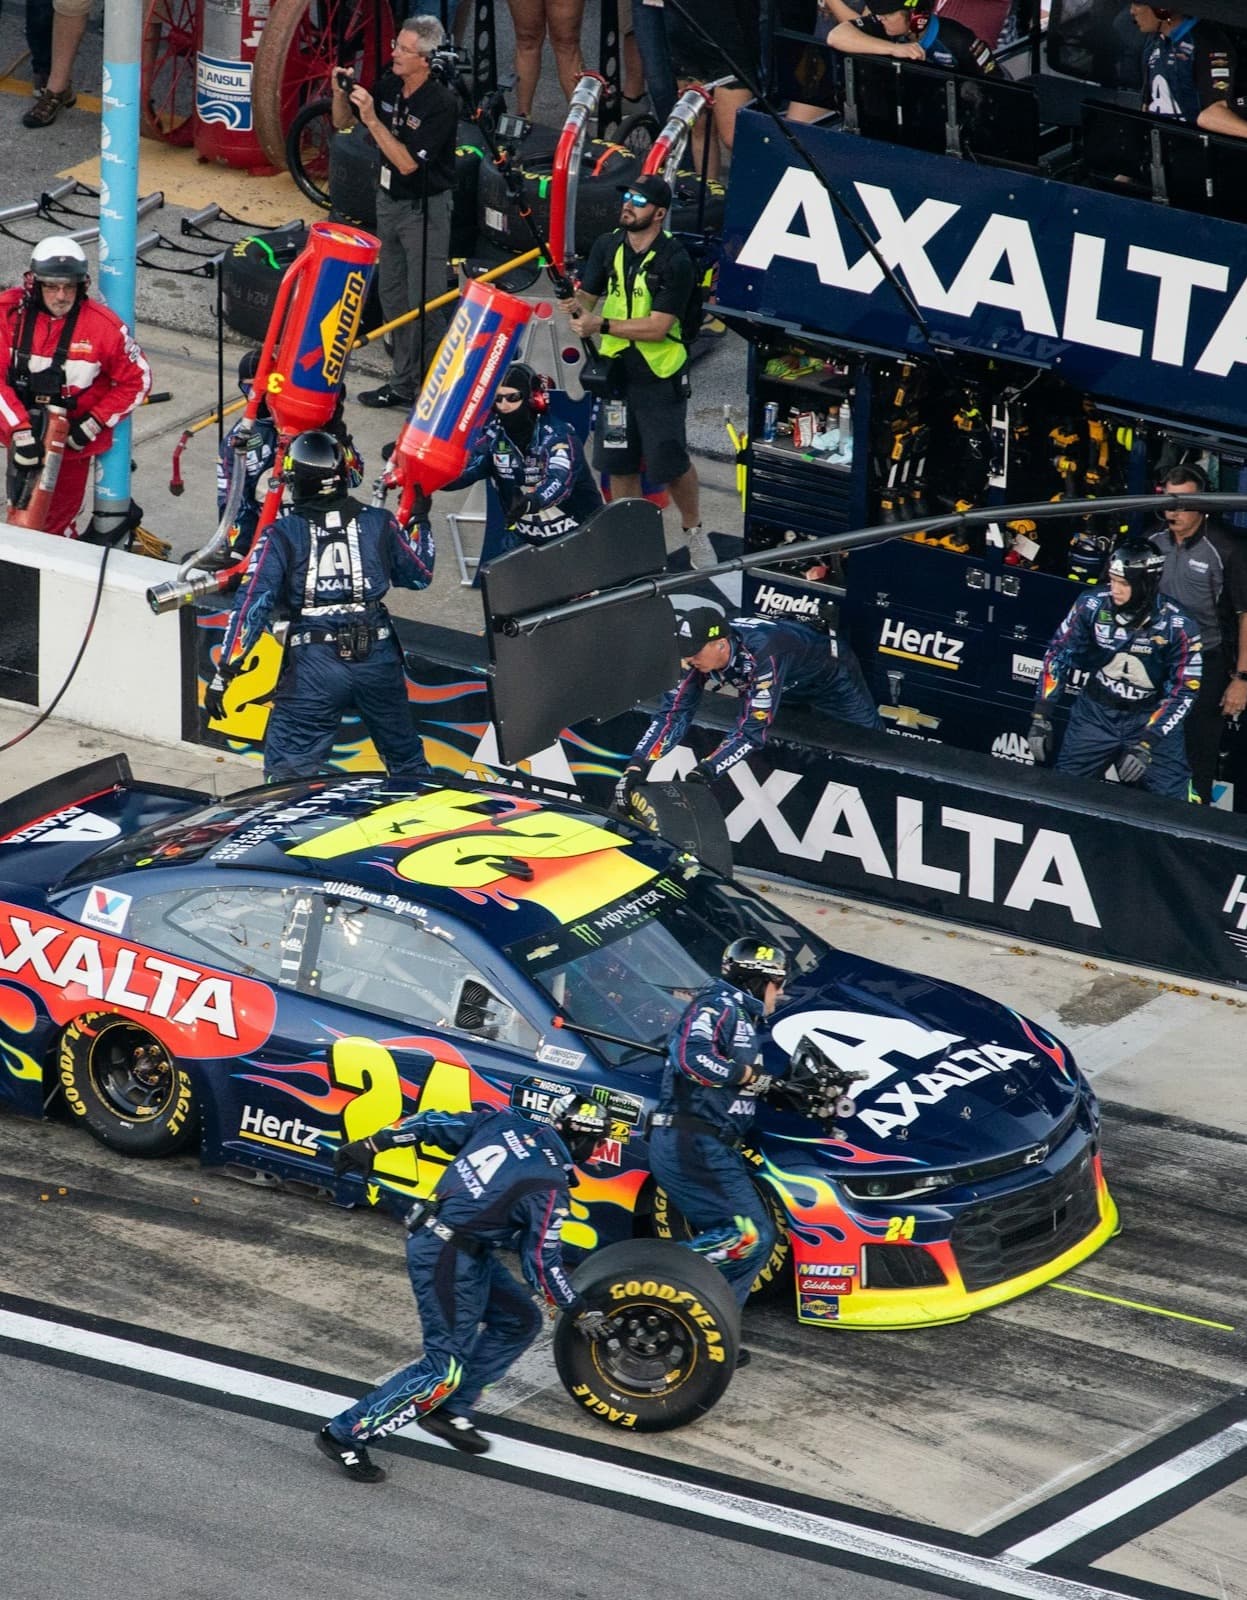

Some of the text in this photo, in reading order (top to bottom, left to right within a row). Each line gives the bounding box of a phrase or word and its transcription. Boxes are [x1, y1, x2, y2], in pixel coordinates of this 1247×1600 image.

[207, 71, 246, 88] ANSUL
[325, 273, 366, 382] SUNOCO
[418, 309, 470, 416] SUNOCO
[482, 333, 509, 378] NASCAR
[268, 373, 285, 393] 3
[317, 578, 372, 591] XALA
[879, 617, 964, 663] Hertz
[1160, 696, 1193, 736] AXALTA
[715, 743, 753, 775] AXALTA
[991, 732, 1035, 760] MAC
[264, 777, 385, 824] AXALTA
[209, 823, 268, 861] SYSTEMS
[222, 824, 284, 861] COATING
[323, 881, 428, 918] William Byron
[594, 889, 666, 931] MONSTER
[755, 946, 774, 961] 24
[695, 1054, 730, 1077] AXALTA
[166, 1071, 192, 1136] EAGLE
[539, 1079, 572, 1095] NASCAR
[855, 1041, 1036, 1139] AXALTA
[329, 1036, 473, 1187] 24
[579, 1103, 597, 1118] 24
[728, 1100, 755, 1115] AXA
[240, 1105, 321, 1150] Hertz
[502, 1129, 531, 1160] RIDDLE
[454, 1158, 486, 1200] AXALTA
[884, 1215, 916, 1242] 24
[549, 1266, 577, 1304] AXALTA
[798, 1264, 856, 1277] MOOG
[802, 1279, 847, 1292] Edelbrock
[609, 1280, 726, 1363] GOODYEAR
[802, 1302, 838, 1312] SUNOCO
[357, 1404, 417, 1440] AXALA
[572, 1383, 638, 1428] EAGLE
